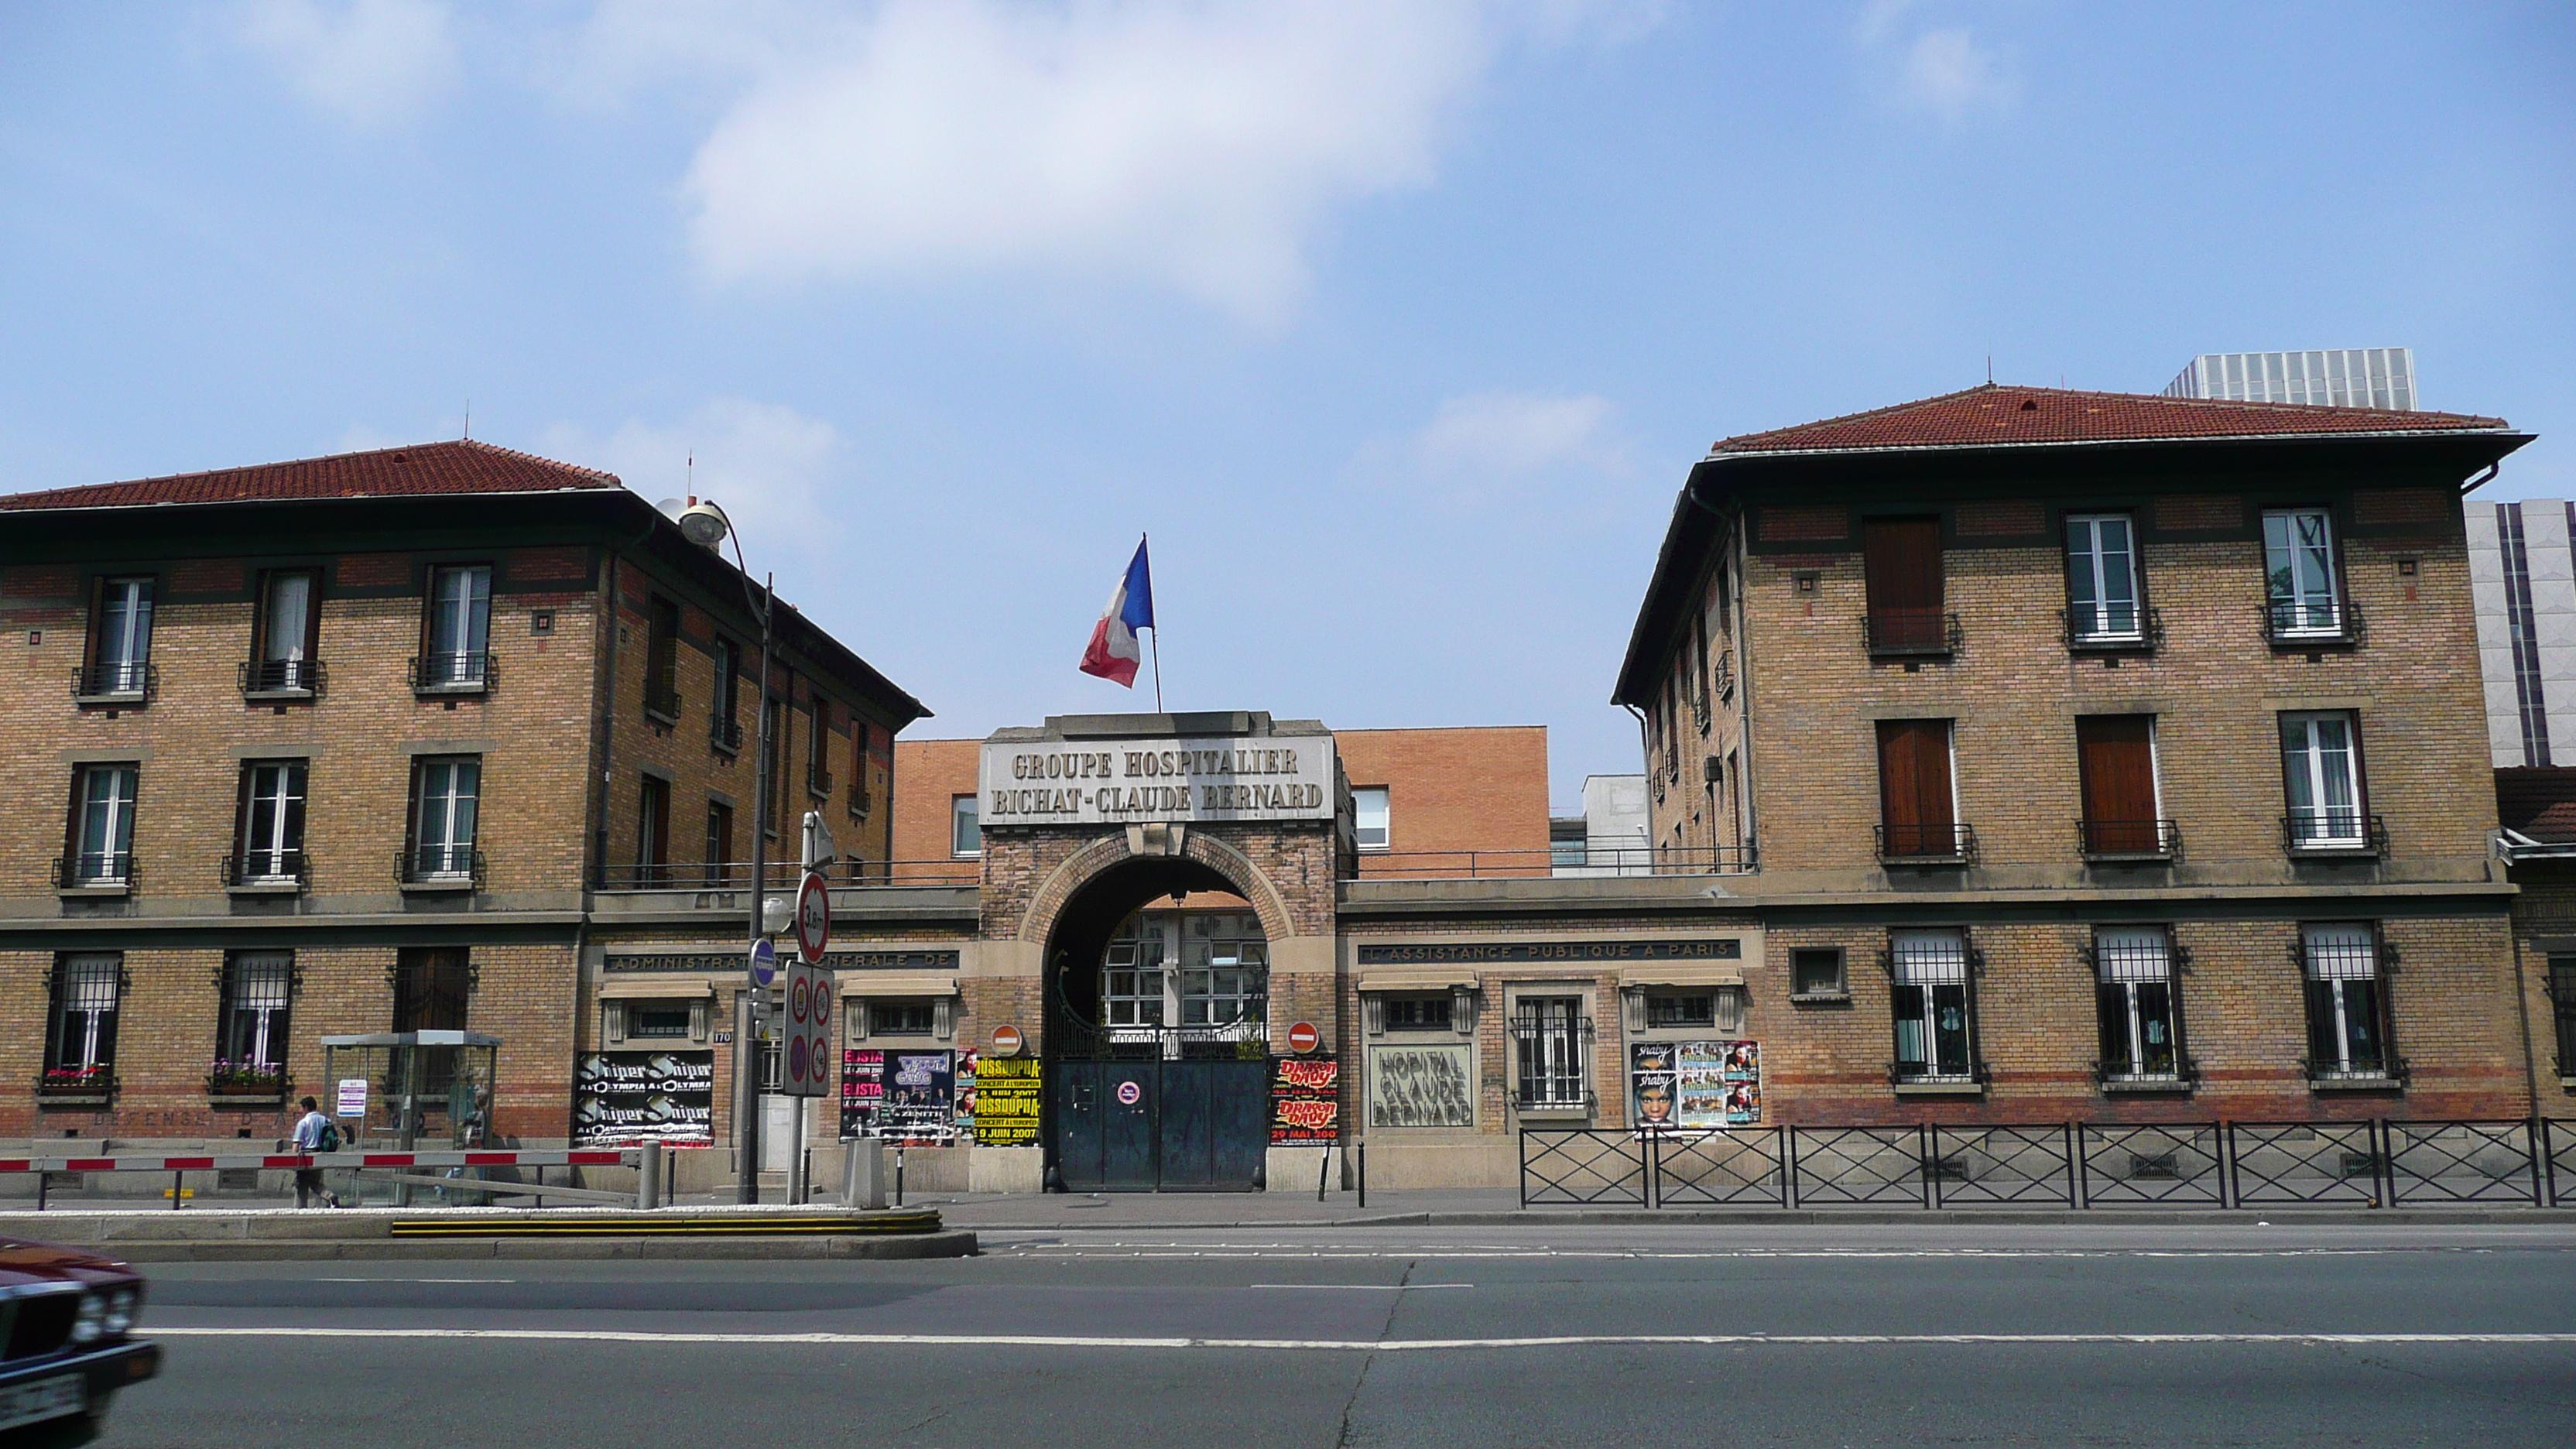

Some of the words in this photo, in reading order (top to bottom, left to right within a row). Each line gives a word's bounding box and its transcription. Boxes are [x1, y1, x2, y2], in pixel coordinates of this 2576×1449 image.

[1012, 752, 1112, 779] GROUPE
[1124, 748, 1298, 776] HOSPITALIER
[991, 785, 1191, 814] BICHAT-CLAUDE
[1201, 783, 1324, 810] BERNARD
[616, 957, 783, 969] ADMINISTRATN
[815, 954, 906, 966] ENERALE
[925, 954, 947, 965] DE
[1370, 947, 1511, 960] L'ASSISTANCE
[1528, 945, 1630, 958] PUBLIQUE
[1669, 944, 1728, 955] PARIS
[715, 1033, 731, 1042] 170
[580, 1053, 646, 1081] Sniper
[647, 1053, 711, 1080] Sniper
[977, 1057, 1040, 1077] OUSSOUPHA
[843, 1083, 882, 1095] ELISTA
[578, 1097, 644, 1124] Sniper
[646, 1095, 710, 1122] Sniper
[975, 1096, 1040, 1116] OUSSOUPHA
[988, 1129, 1010, 1138] JUIN
[1012, 1129, 1036, 1138] 2007
